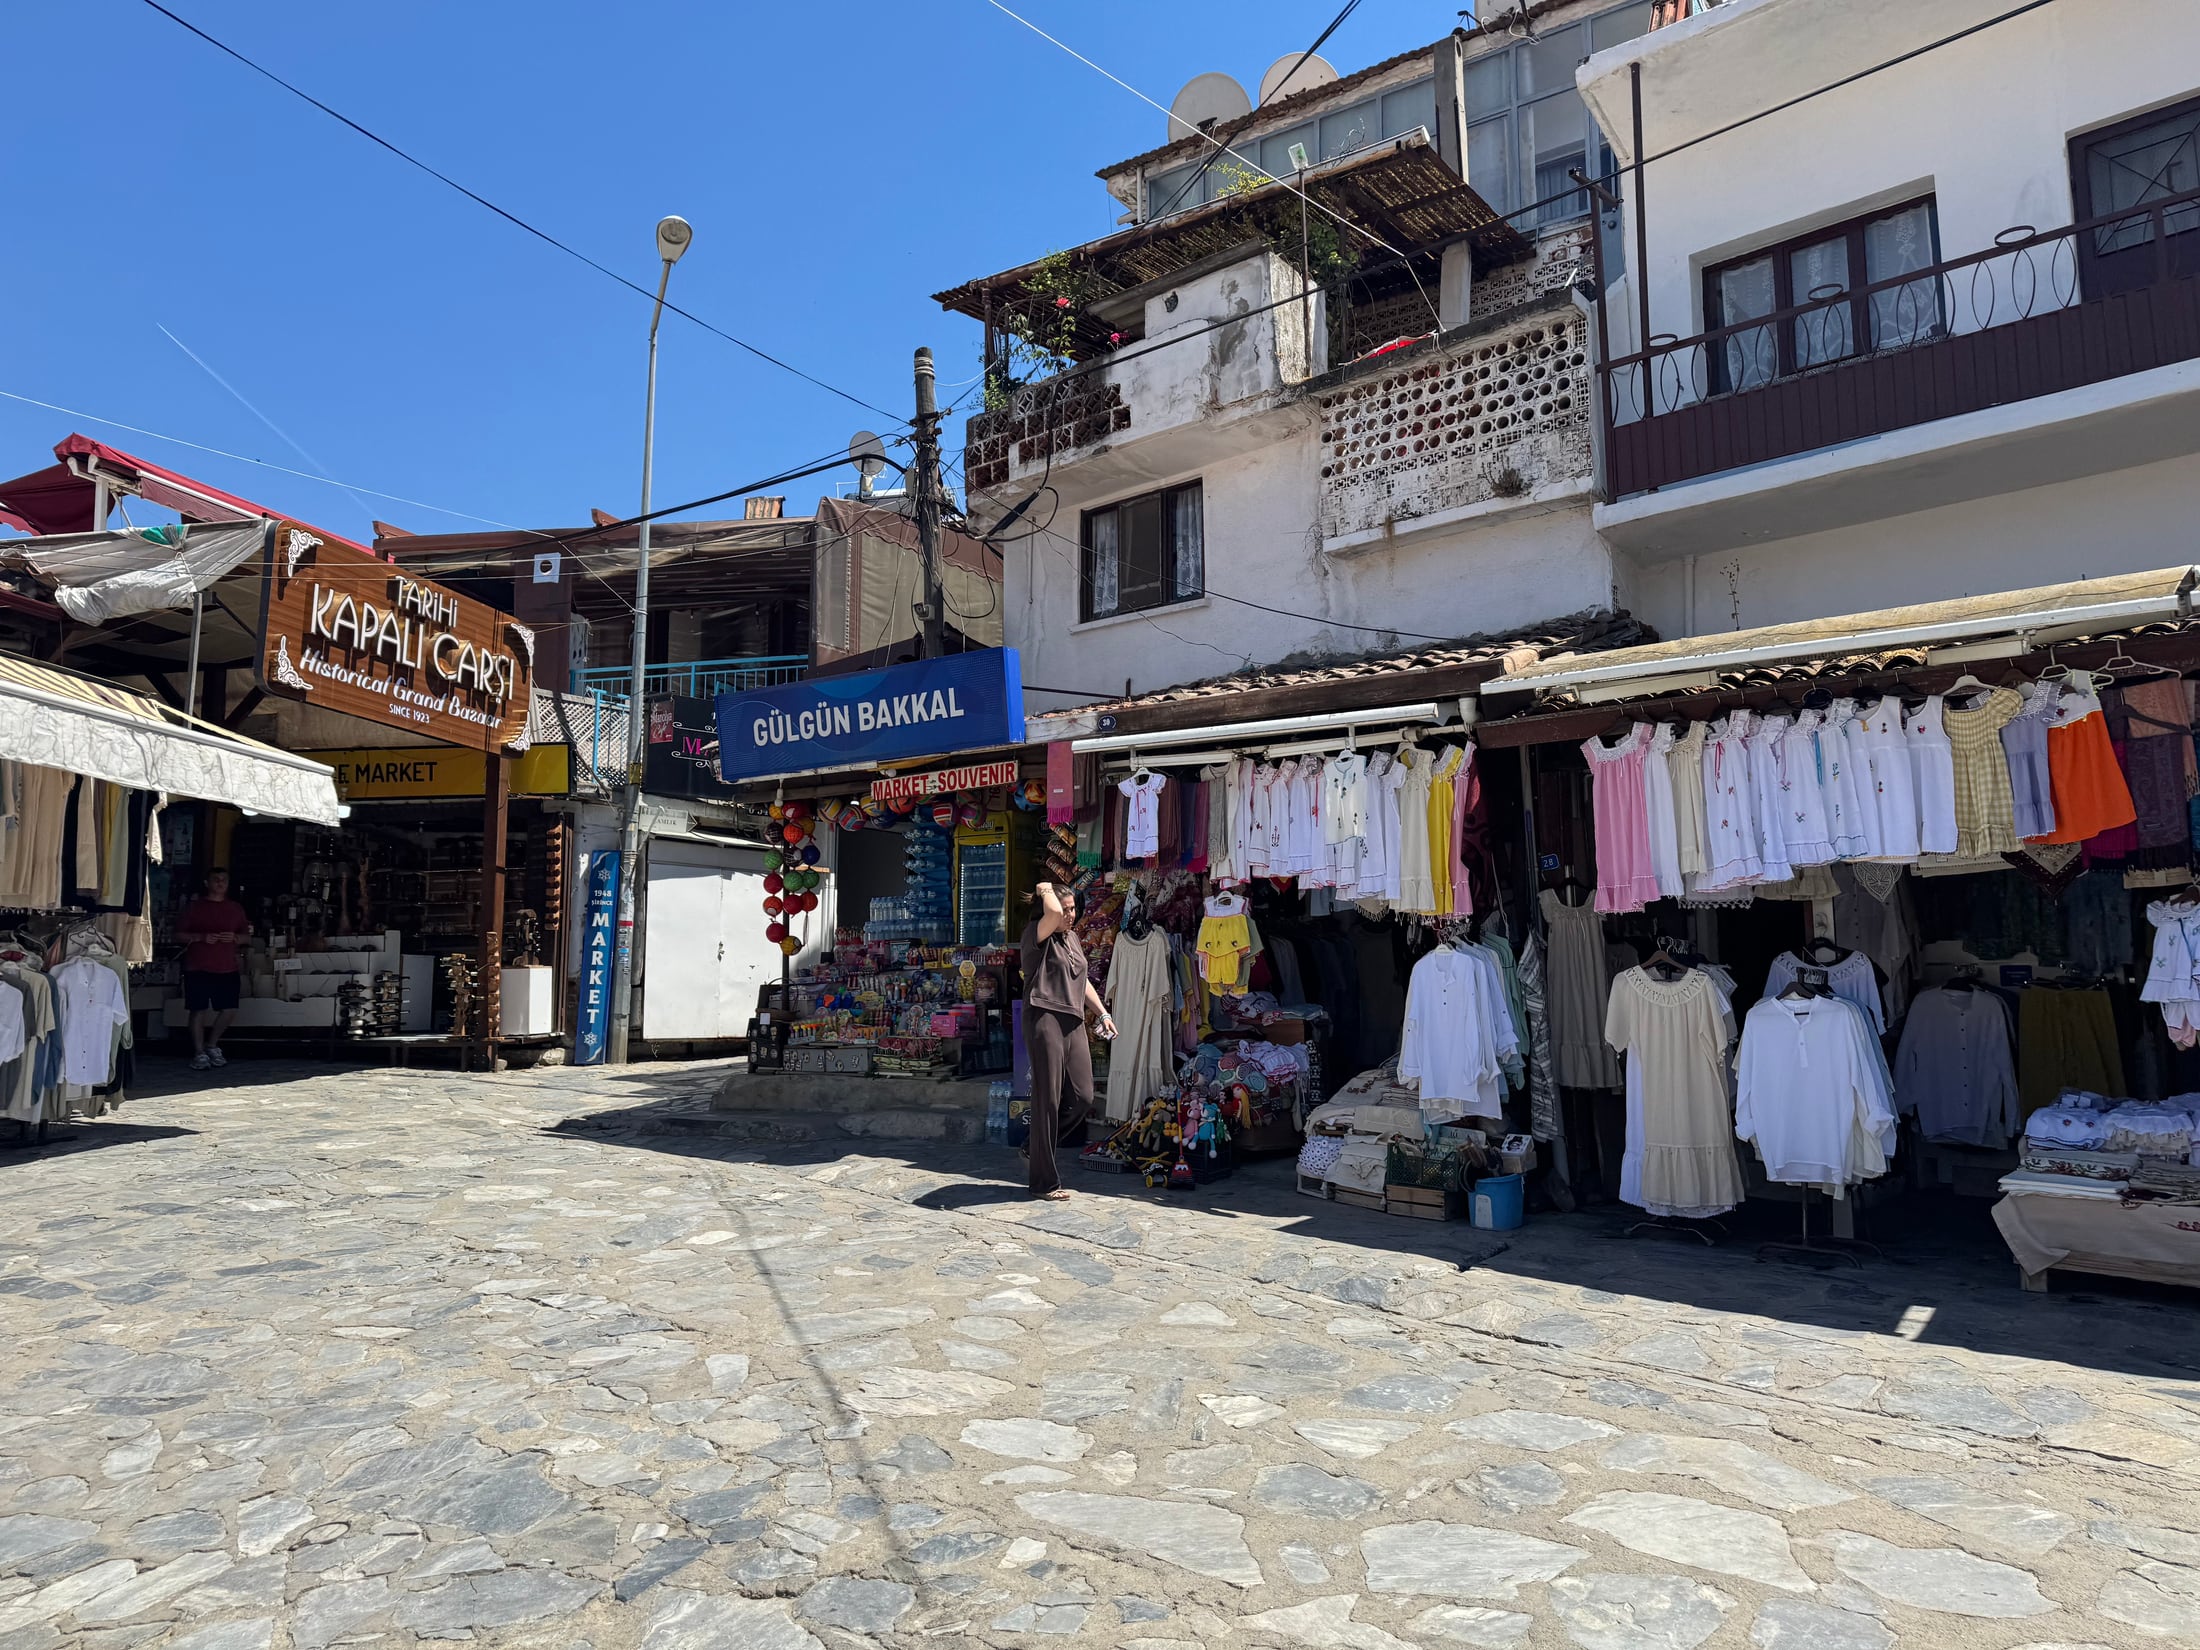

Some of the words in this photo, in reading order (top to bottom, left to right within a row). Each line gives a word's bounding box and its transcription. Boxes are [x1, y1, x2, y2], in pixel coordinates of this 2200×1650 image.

[310, 583, 424, 670] KAPALI
[299, 646, 392, 696] Historical
[392, 676, 448, 712] Grand
[448, 695, 503, 729] Bazaar
[388, 703, 411, 719] SINCE
[413, 709, 430, 724] 1923
[753, 701, 851, 747] GÜLGÜN
[857, 687, 965, 732] BAKKAL
[355, 761, 438, 784] MARKET
[872, 775, 929, 801] MARKET
[937, 762, 1016, 792] SOUVENIR
[1543, 858, 1554, 868] 28
[586, 912, 610, 1025] MARKET
